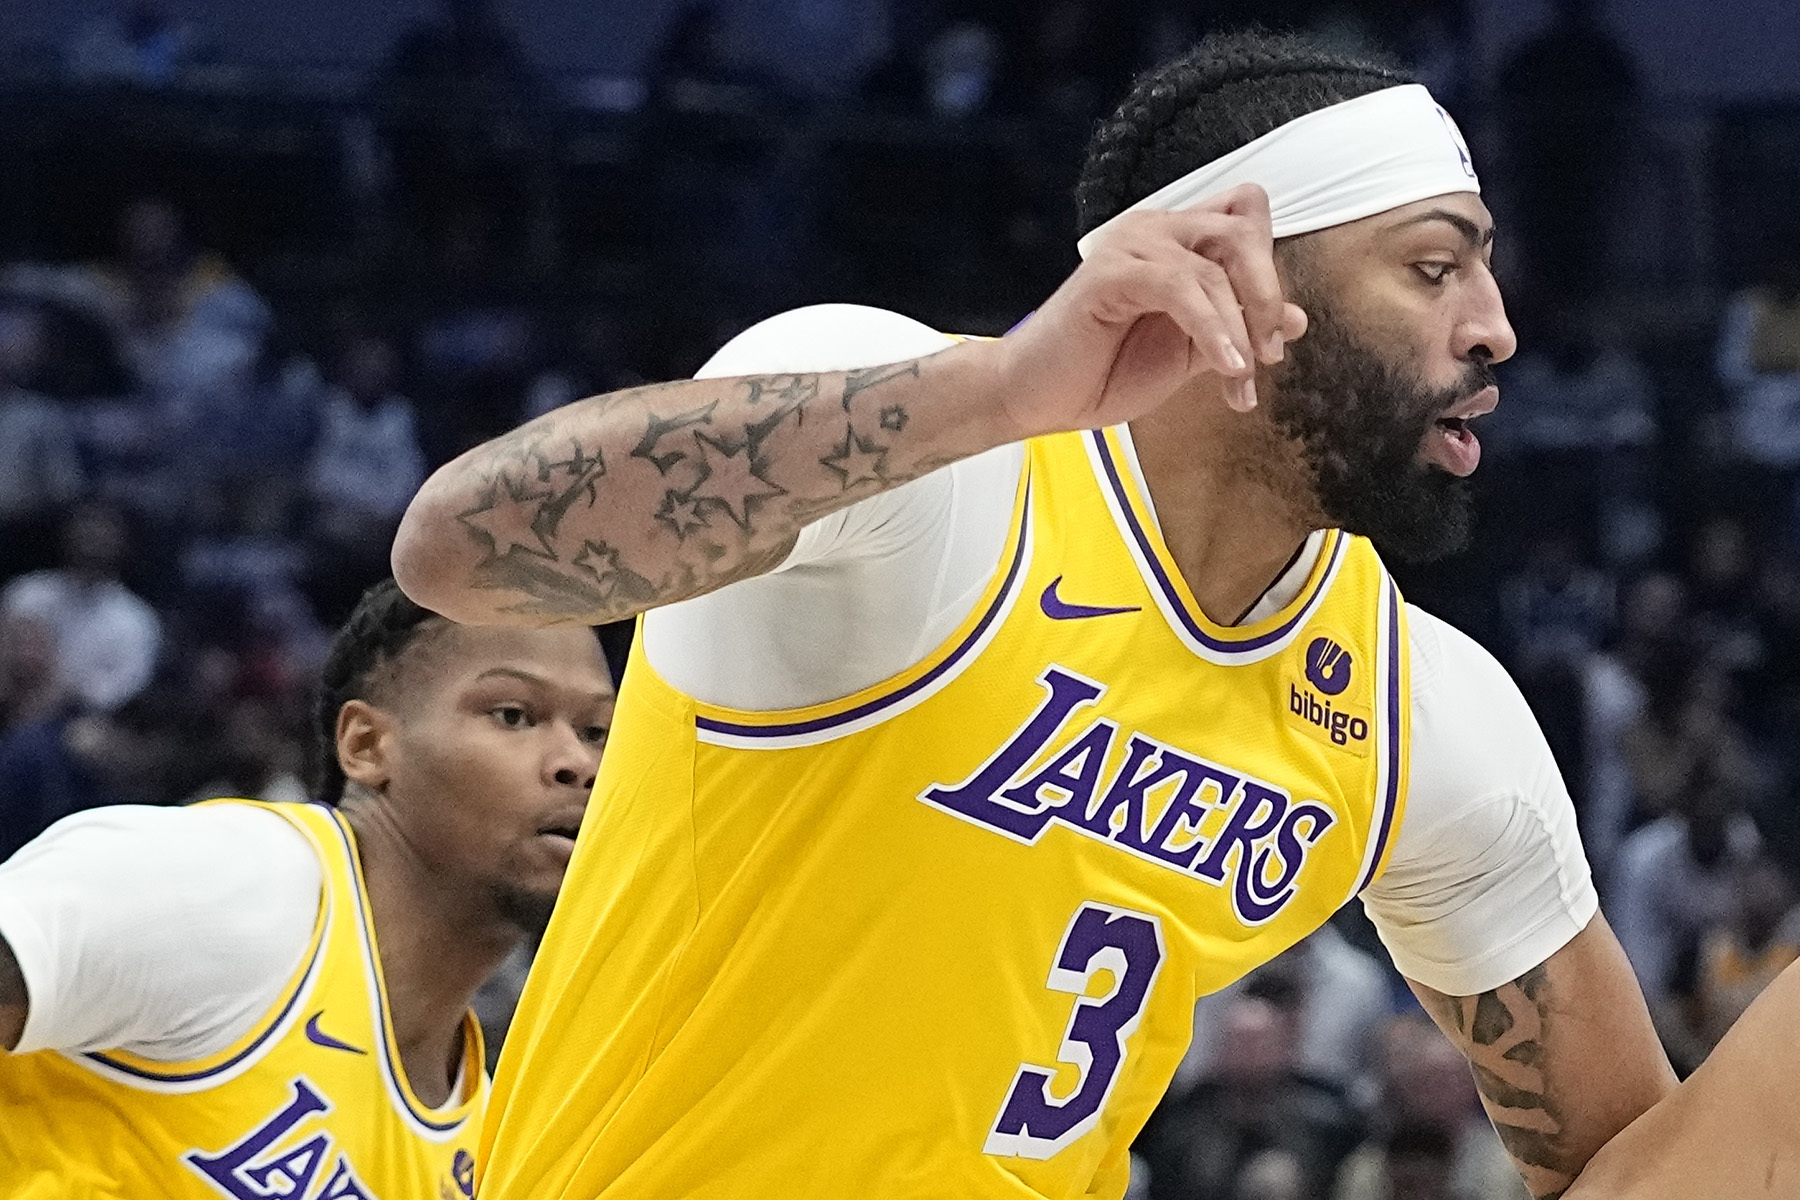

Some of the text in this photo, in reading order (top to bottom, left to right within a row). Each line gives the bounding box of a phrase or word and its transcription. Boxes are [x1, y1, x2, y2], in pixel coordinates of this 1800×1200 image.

[917, 664, 1337, 926] LAKERS
[1290, 682, 1368, 746] bibigo
[983, 900, 1167, 1160] 3
